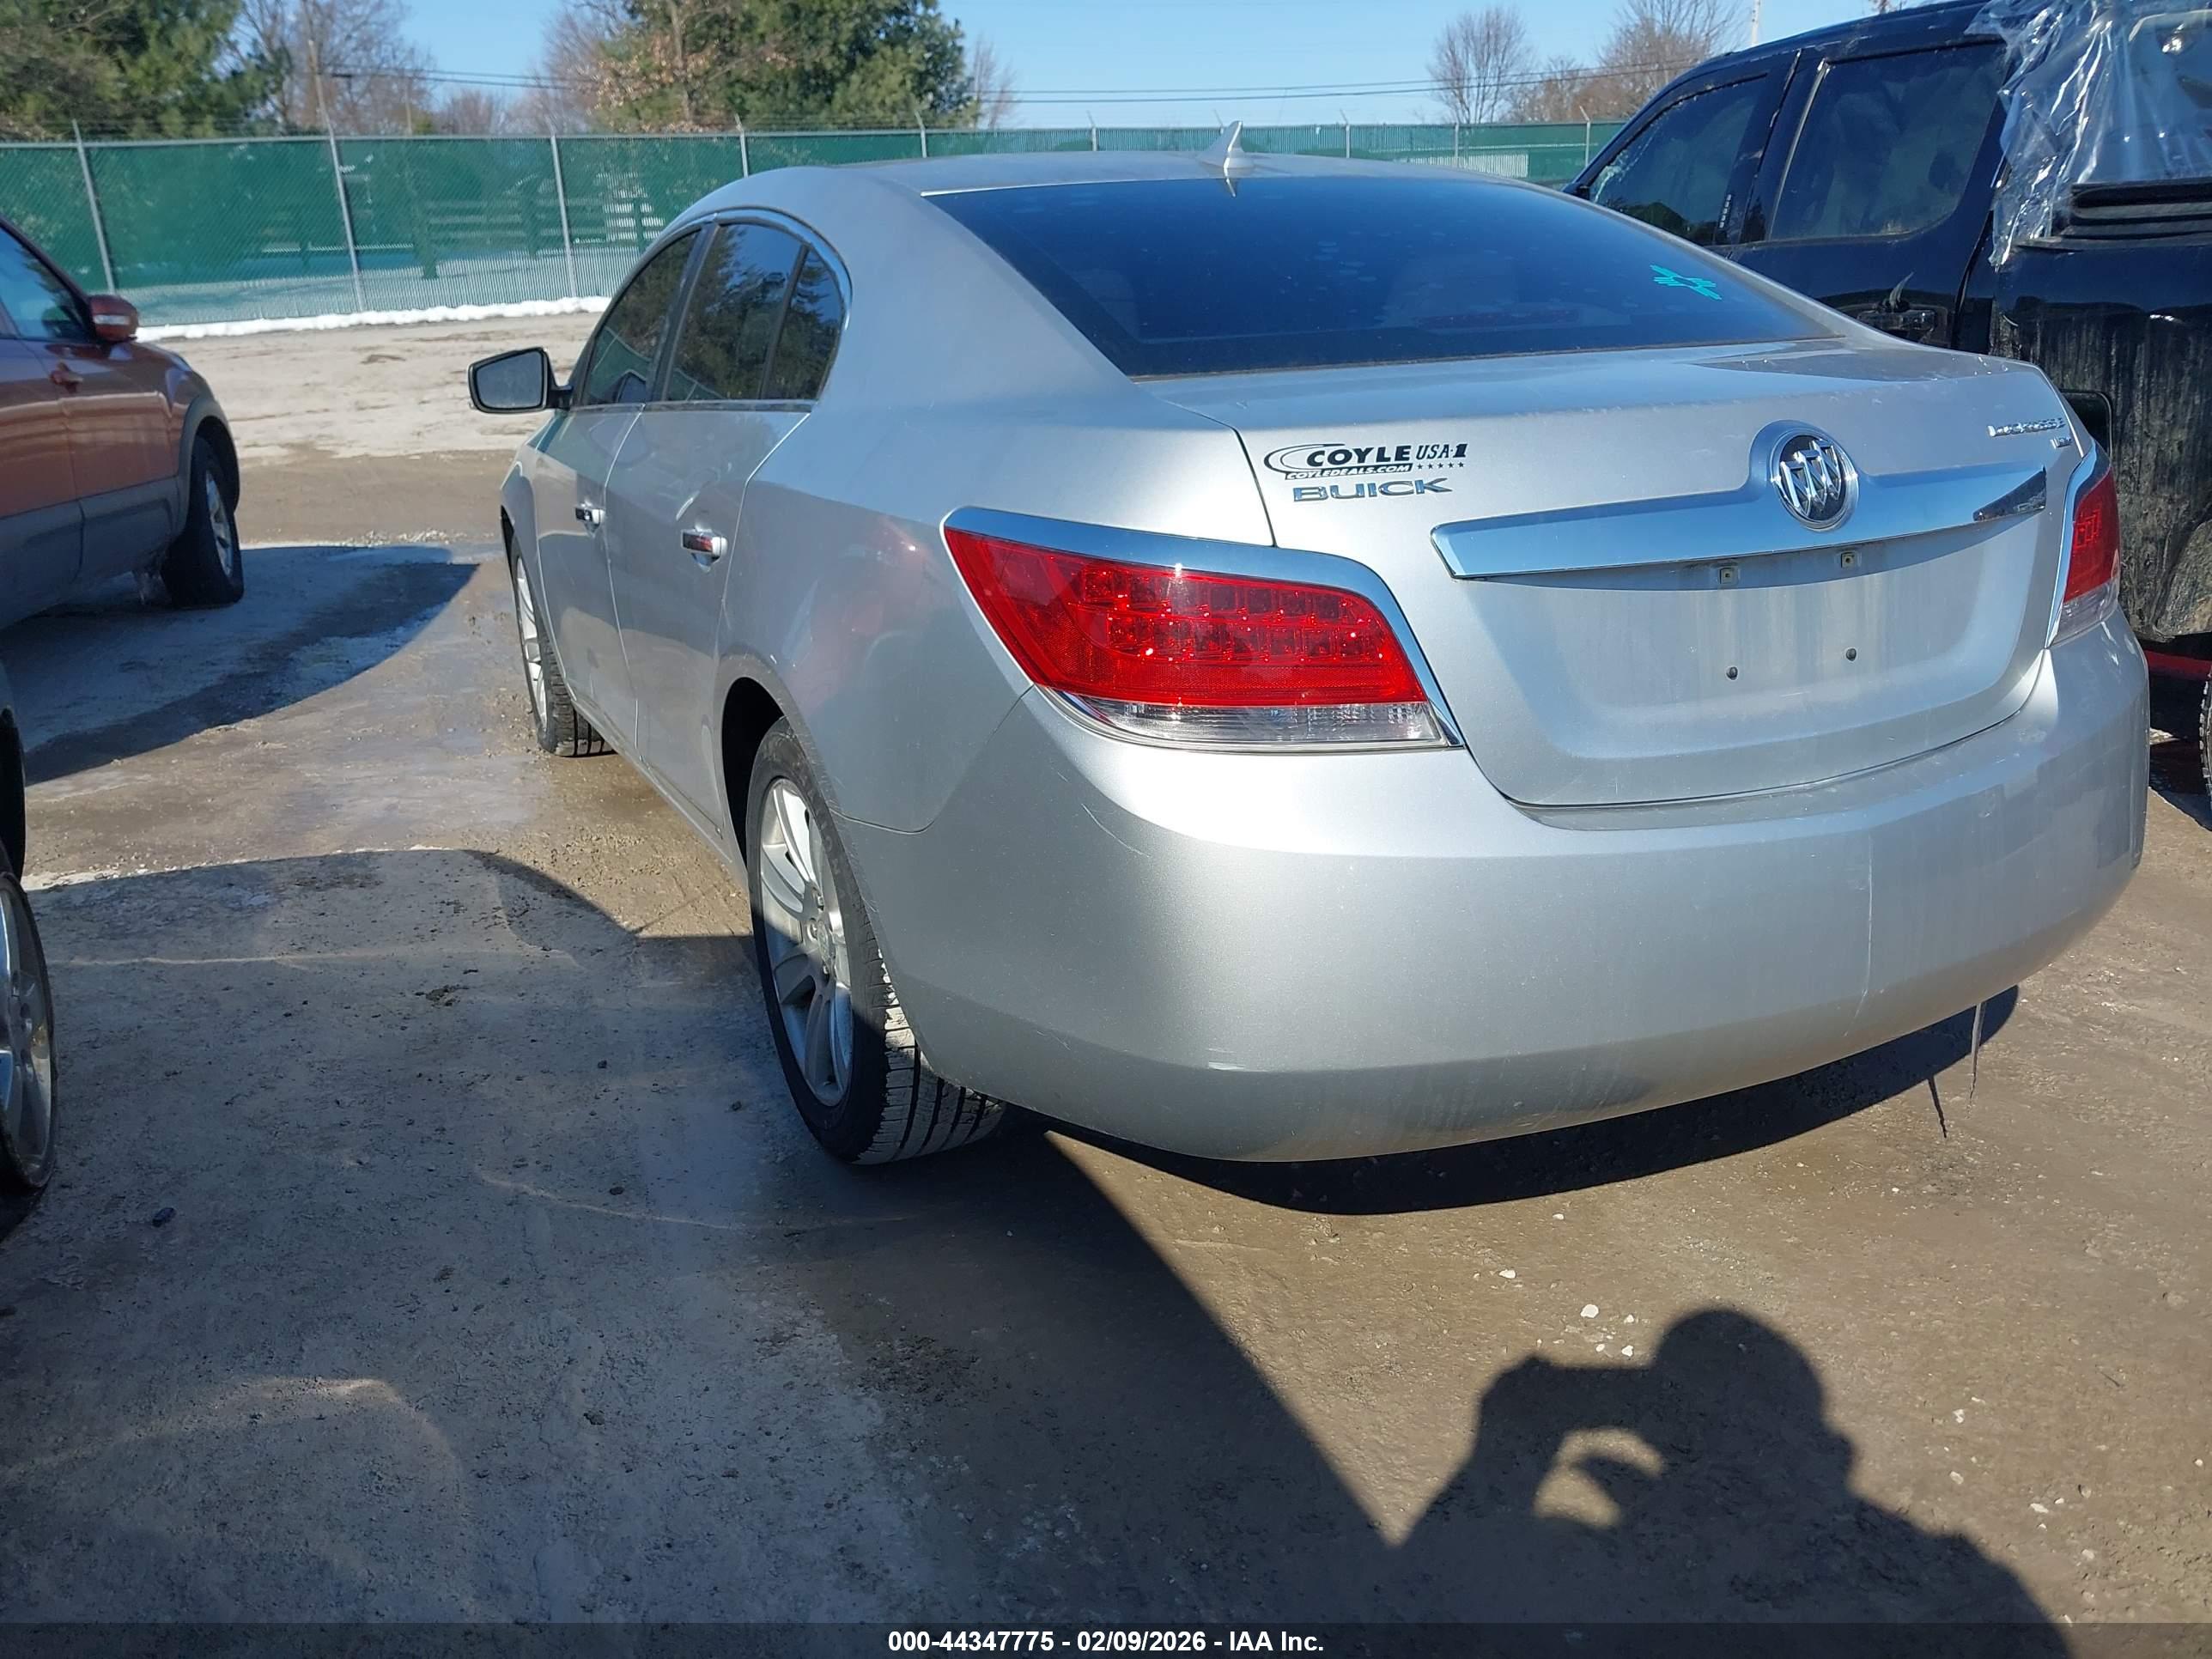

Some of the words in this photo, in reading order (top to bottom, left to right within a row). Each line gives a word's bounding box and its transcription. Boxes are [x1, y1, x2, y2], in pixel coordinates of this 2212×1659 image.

[1306, 445, 1412, 467] COYLE
[1287, 465, 1410, 480] COYLEDEALS.COM
[1292, 477, 1453, 502] BUICK
